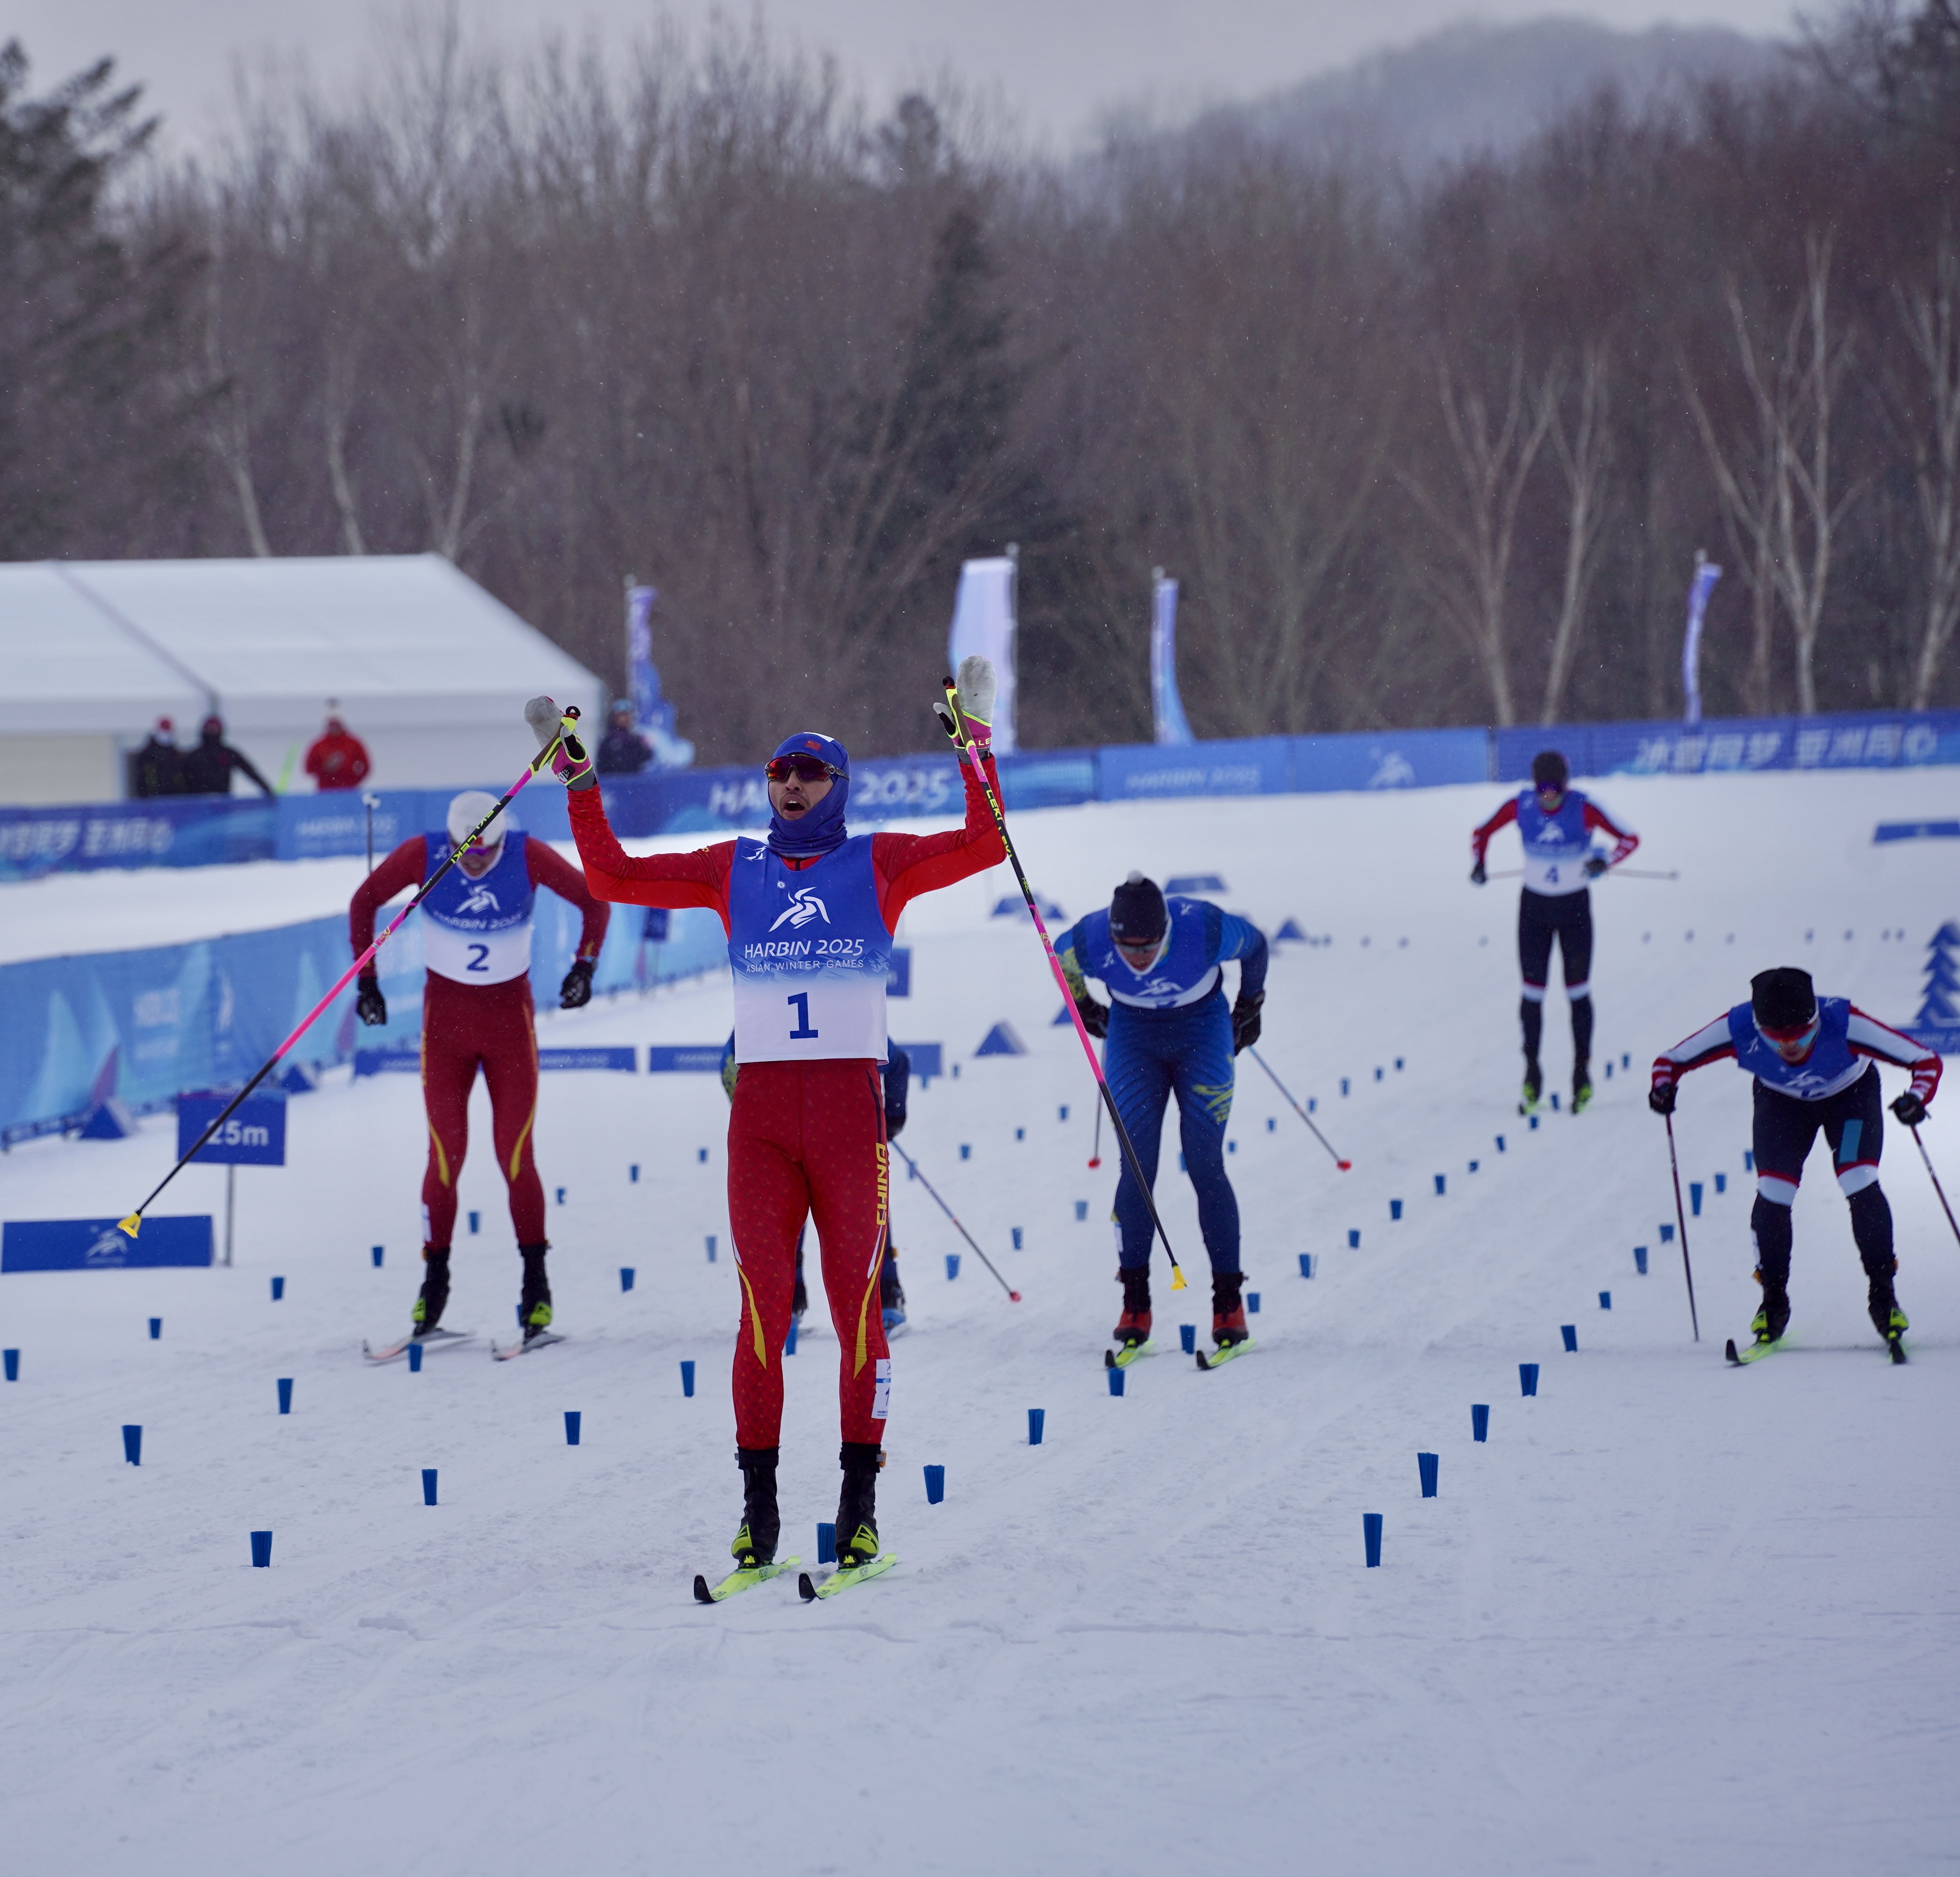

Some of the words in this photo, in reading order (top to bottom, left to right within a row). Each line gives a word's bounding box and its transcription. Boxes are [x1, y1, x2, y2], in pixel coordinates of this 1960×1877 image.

[978, 737, 992, 746] LE
[853, 768, 953, 809] 2025
[986, 790, 1003, 821] LEKI
[451, 834, 477, 864] LEKI
[1544, 865, 1559, 884] 4
[466, 943, 490, 972] 2
[745, 940, 811, 959] HARBIN
[816, 939, 865, 956] 2025
[746, 963, 771, 973] ASIAN
[775, 960, 820, 970] WINTER
[826, 960, 864, 969] GAMES
[787, 992, 819, 1040] 1
[206, 1118, 269, 1147] 25m
[875, 1142, 887, 1226] CHINA
